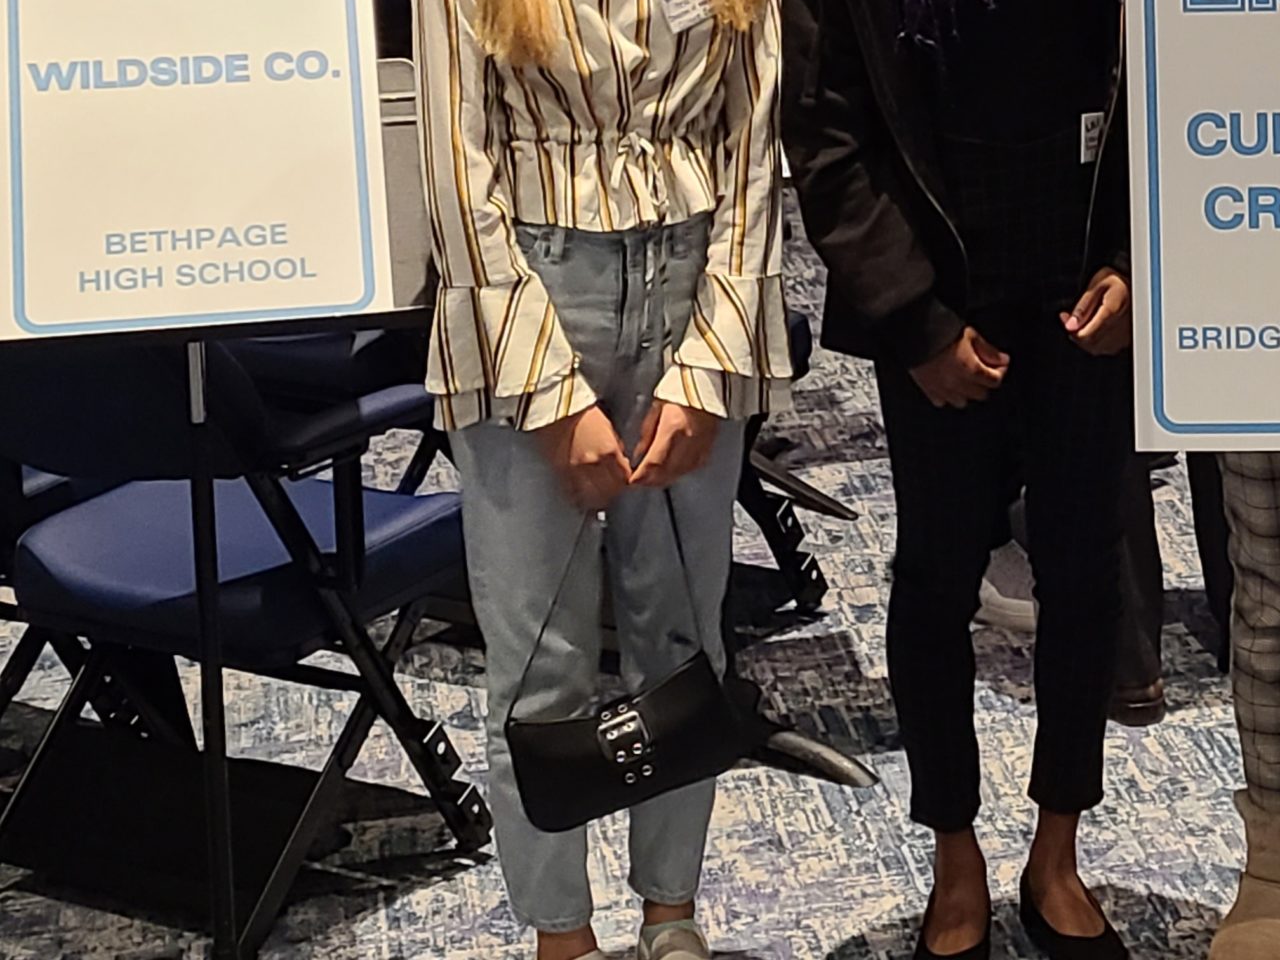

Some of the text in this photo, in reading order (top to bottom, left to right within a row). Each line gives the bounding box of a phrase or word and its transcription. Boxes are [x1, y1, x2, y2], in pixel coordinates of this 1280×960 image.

[28, 51, 341, 91] WILDSIDE CO.
[105, 223, 288, 255] BETHPAGE
[79, 257, 317, 292] HIGH SCHOOL
